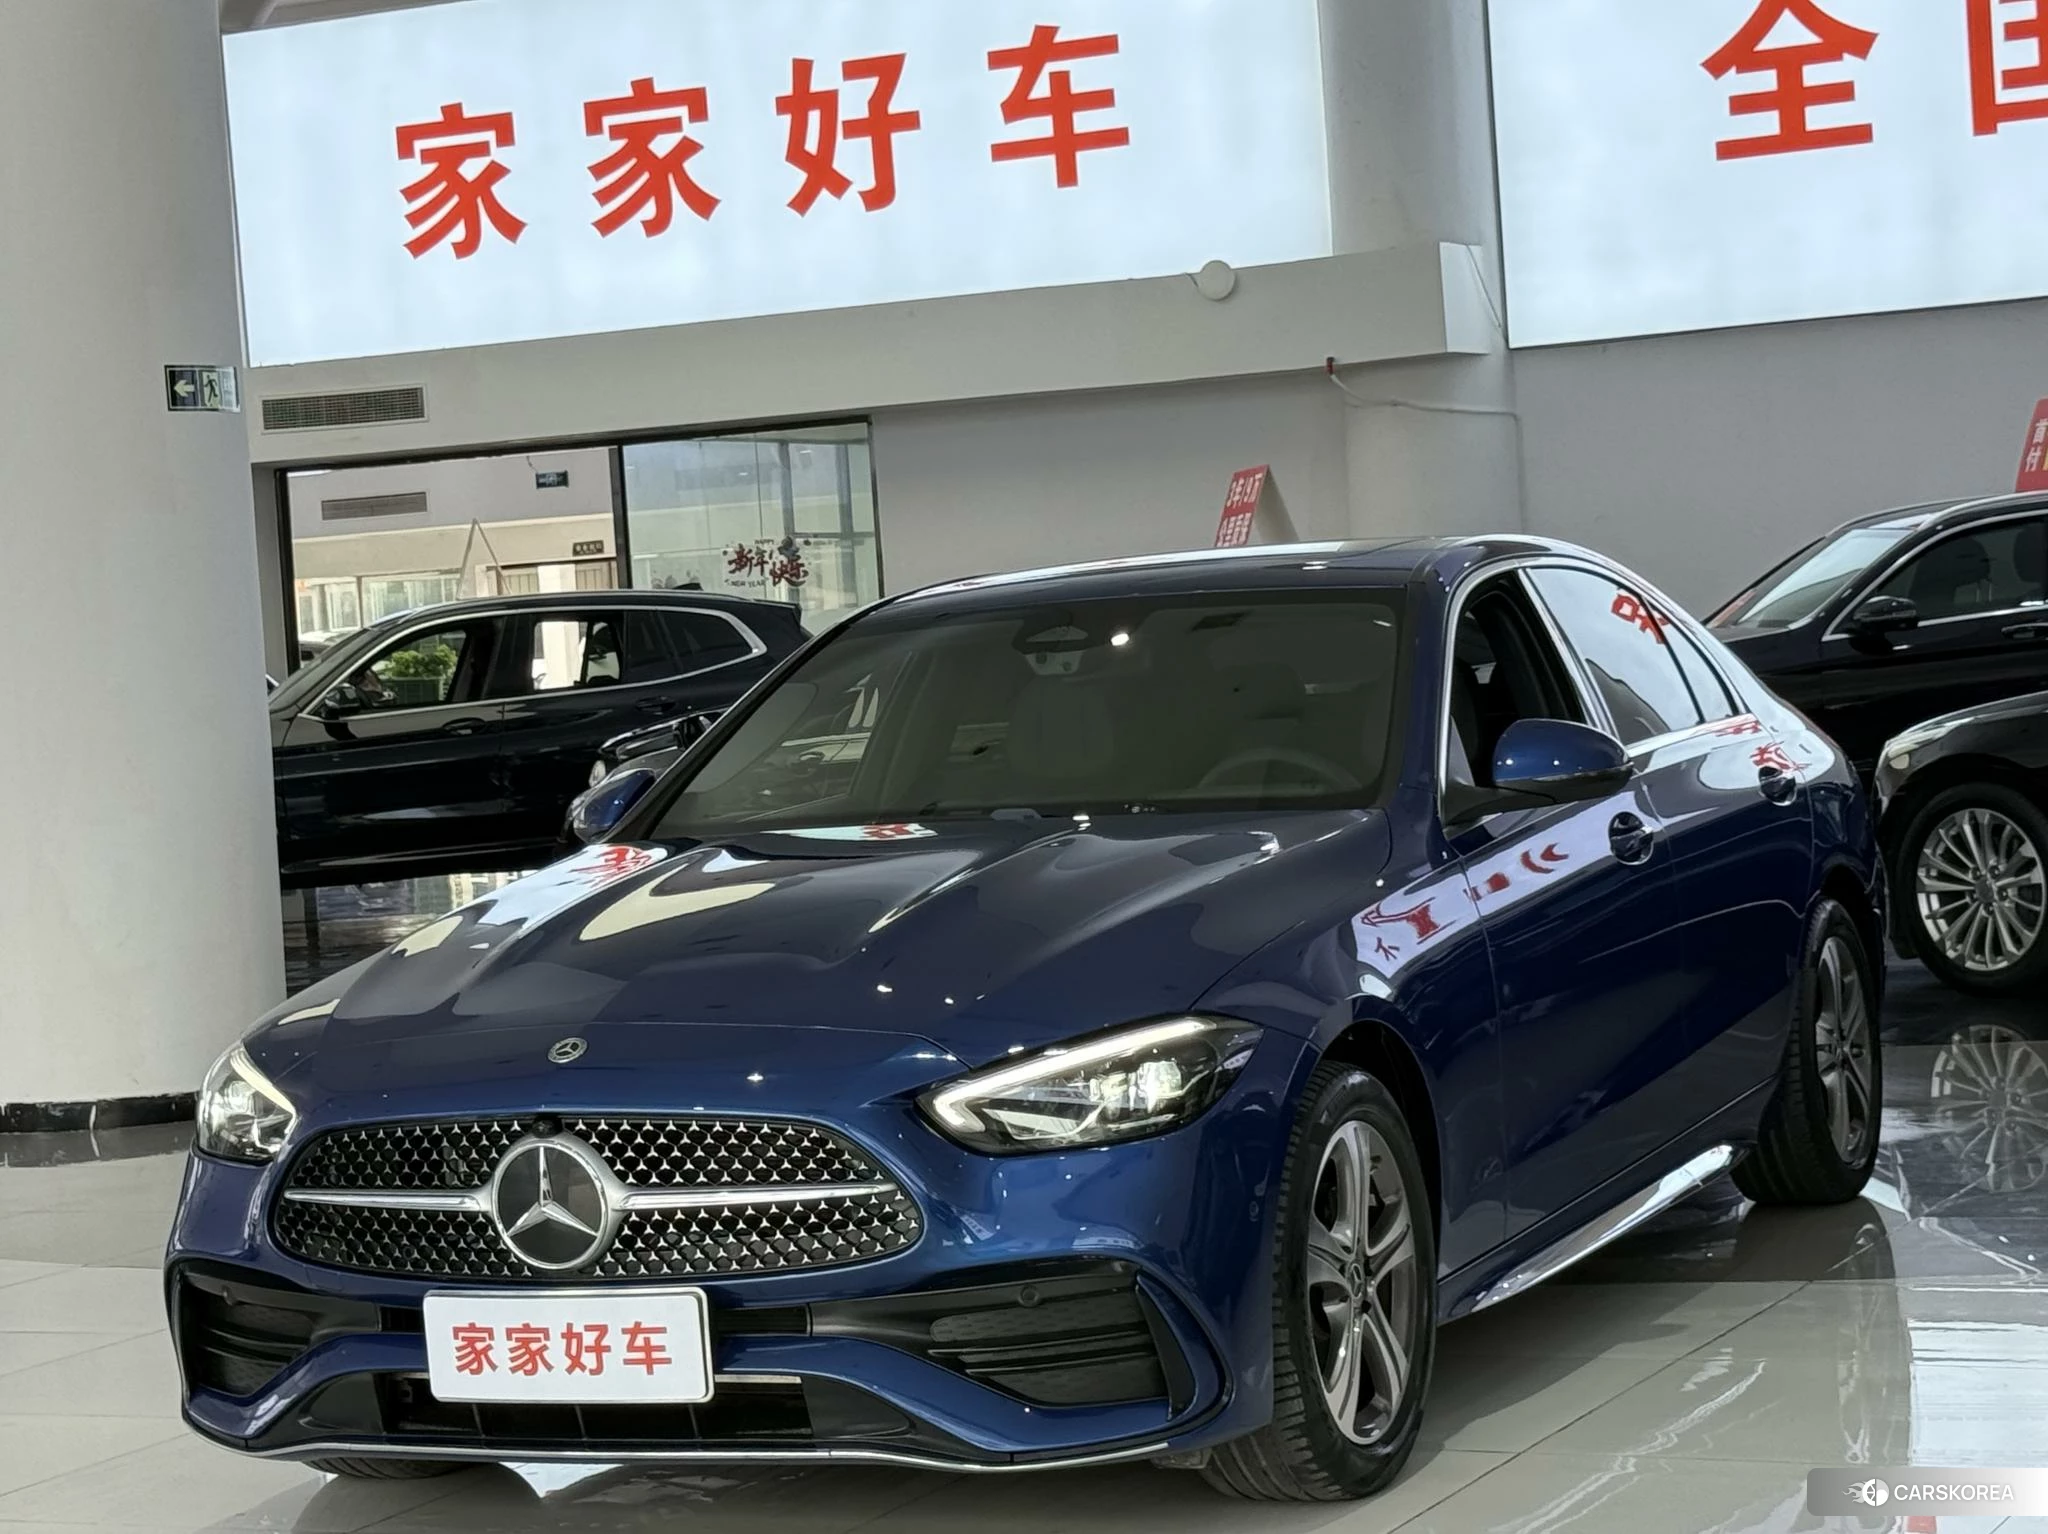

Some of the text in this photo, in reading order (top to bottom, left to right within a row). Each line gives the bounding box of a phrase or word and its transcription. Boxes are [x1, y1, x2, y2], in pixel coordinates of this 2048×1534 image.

[395, 24, 1130, 260] 家家好车
[452, 1321, 673, 1377] 家家好车
